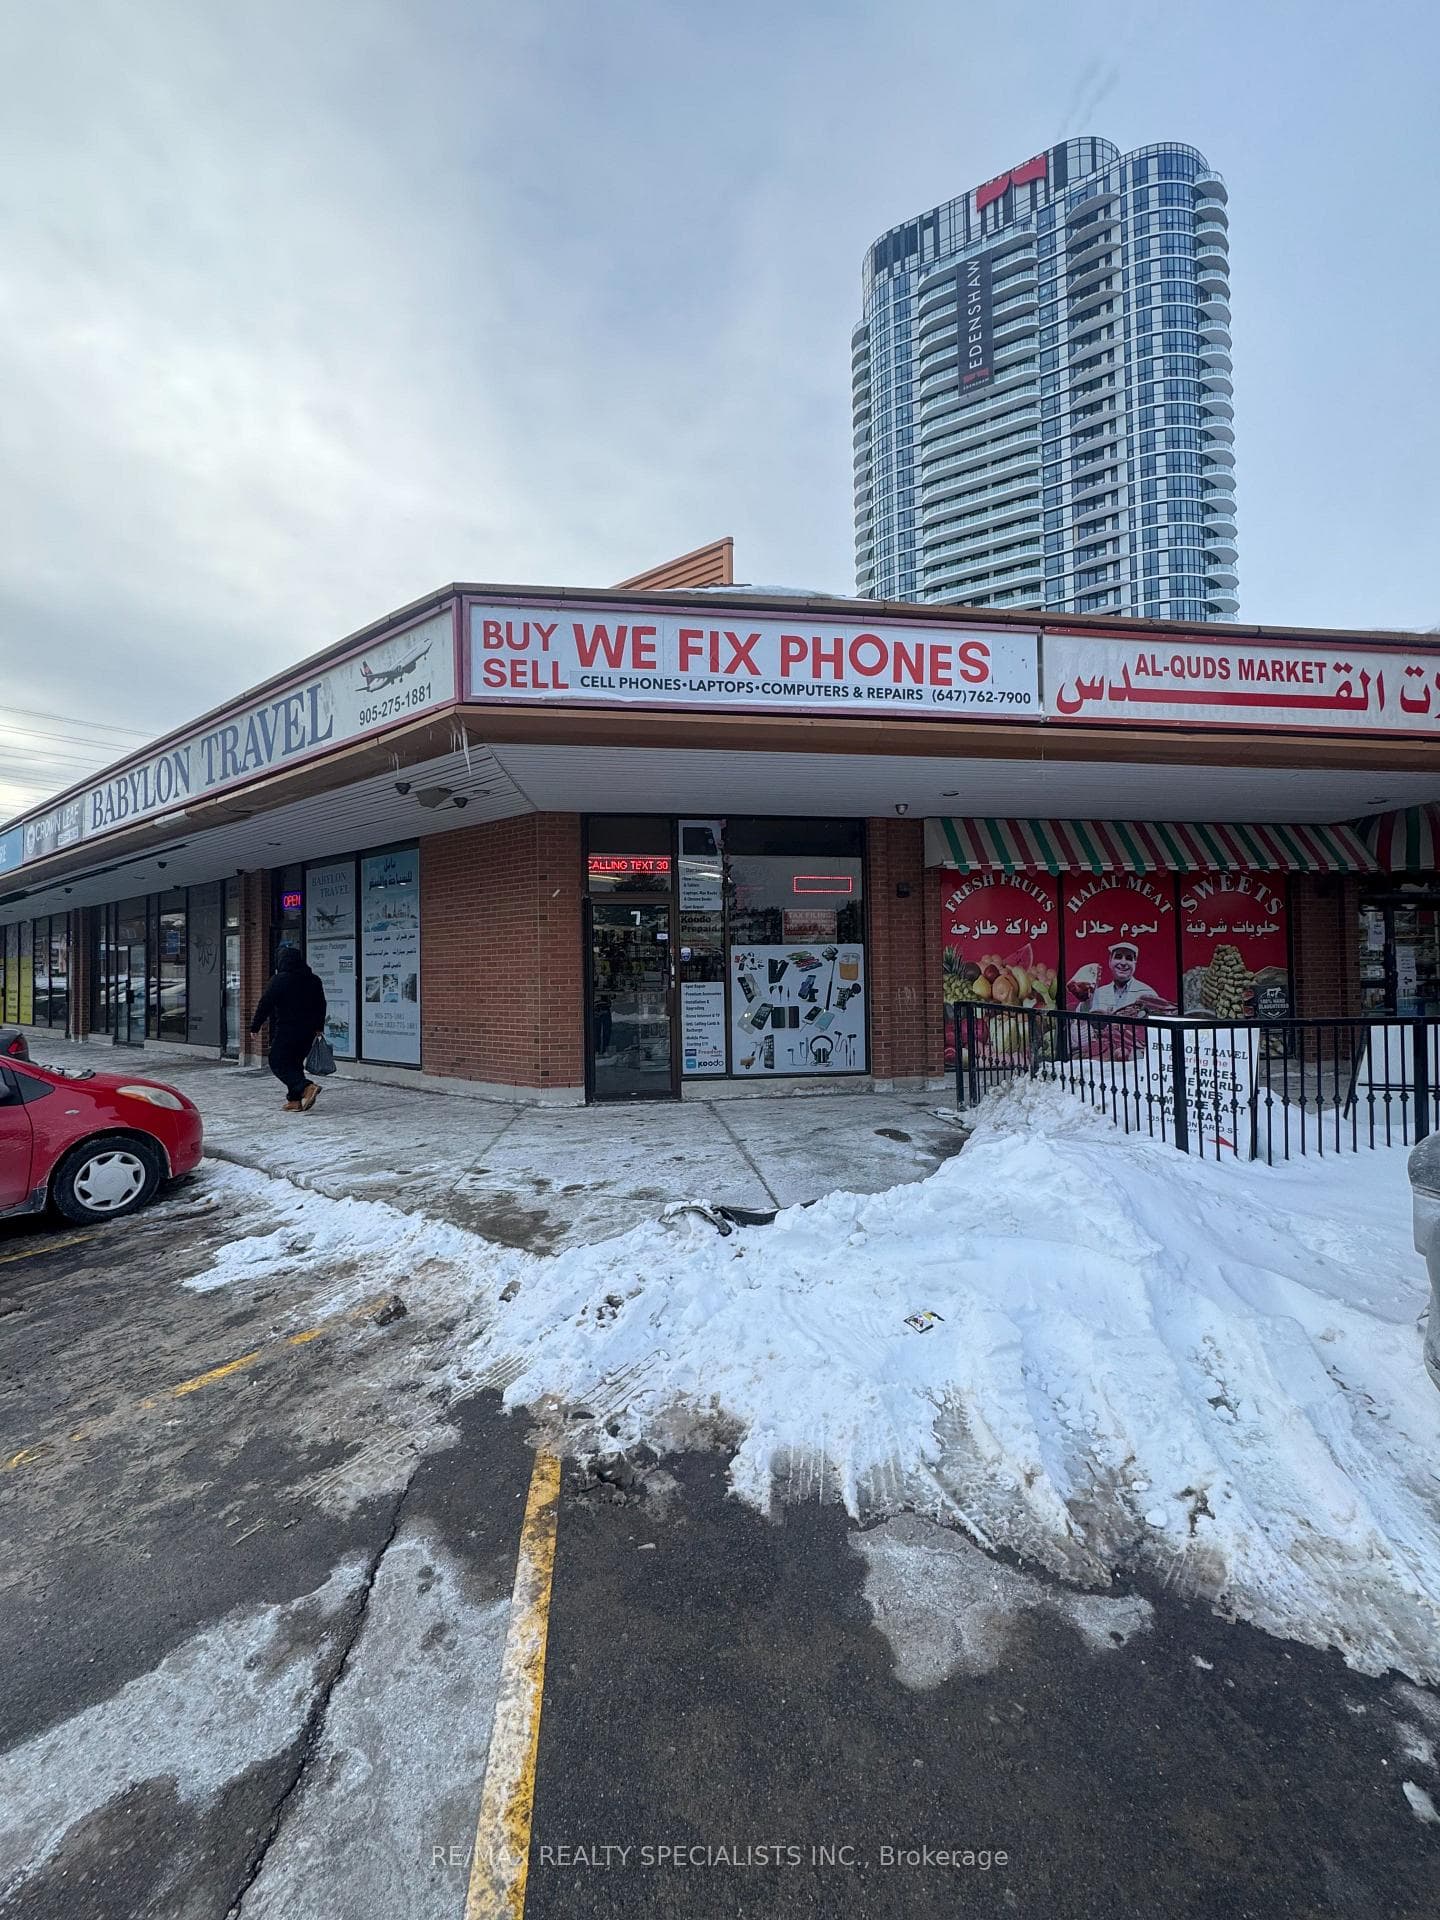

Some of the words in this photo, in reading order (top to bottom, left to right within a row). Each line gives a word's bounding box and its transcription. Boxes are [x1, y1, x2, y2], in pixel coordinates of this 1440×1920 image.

[966, 260, 983, 369] EDENSHAW
[482, 620, 559, 651] BUY
[572, 623, 656, 669] WE
[679, 629, 762, 676] FIX
[780, 633, 991, 686] PHONES
[483, 658, 569, 689] SELL
[1135, 653, 1231, 680] AL-QUDS
[1239, 658, 1327, 684] MARKET
[580, 675, 615, 689] CELL
[853, 686, 863, 698] &
[867, 687, 923, 700] REPAIRS
[359, 682, 432, 726] 905-275-1881
[90, 746, 193, 830] BABYLON
[201, 682, 334, 786] TRAVEL
[630, 860, 654, 870] TEXT
[311, 872, 348, 887] BABYLON
[283, 894, 301, 907] OPEN
[320, 883, 350, 898] TRAVEL
[945, 874, 995, 913] FRESH
[1000, 873, 1055, 913] FRUITS
[1066, 875, 1121, 914] HALAL
[1127, 875, 1175, 914] MEAT
[1181, 874, 1284, 916] SWEETS
[631, 911, 641, 926] 7
[1186, 918, 1227, 938] شرقية
[950, 919, 998, 940] طازجة
[1075, 920, 1115, 938] حلال
[1120, 920, 1158, 938] لحوم
[1232, 920, 1280, 940] حلويات
[1152, 1043, 1200, 1055] BABON
[1204, 1047, 1249, 1060] TRAVEL
[1193, 1068, 1237, 1080] PRICES
[1167, 1085, 1223, 1100] ALINES
[1199, 1078, 1244, 1092] WORLD
[1215, 1101, 1247, 1116] AST
